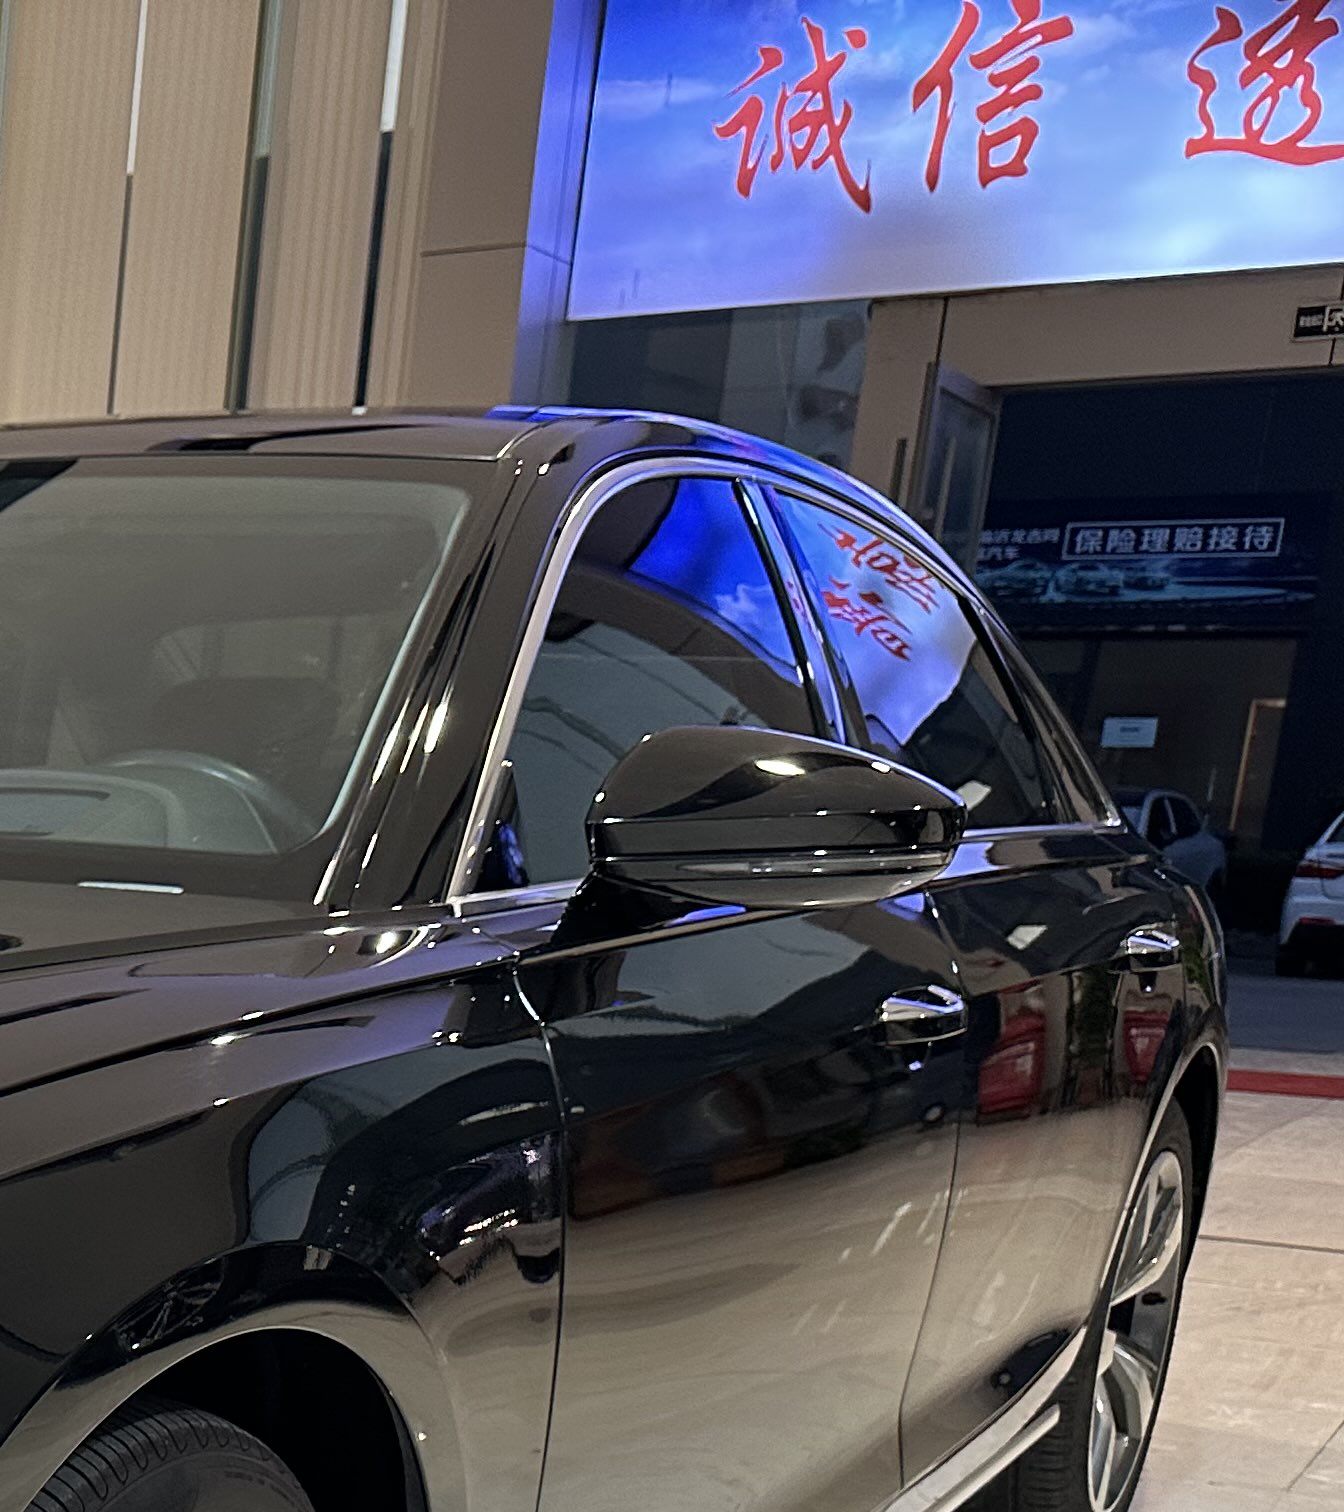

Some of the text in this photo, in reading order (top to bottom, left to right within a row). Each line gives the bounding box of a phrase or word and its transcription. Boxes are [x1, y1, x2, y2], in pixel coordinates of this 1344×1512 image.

[713, 0, 1075, 214] 诚信
[1075, 525, 1274, 554] 保险理赔接待
